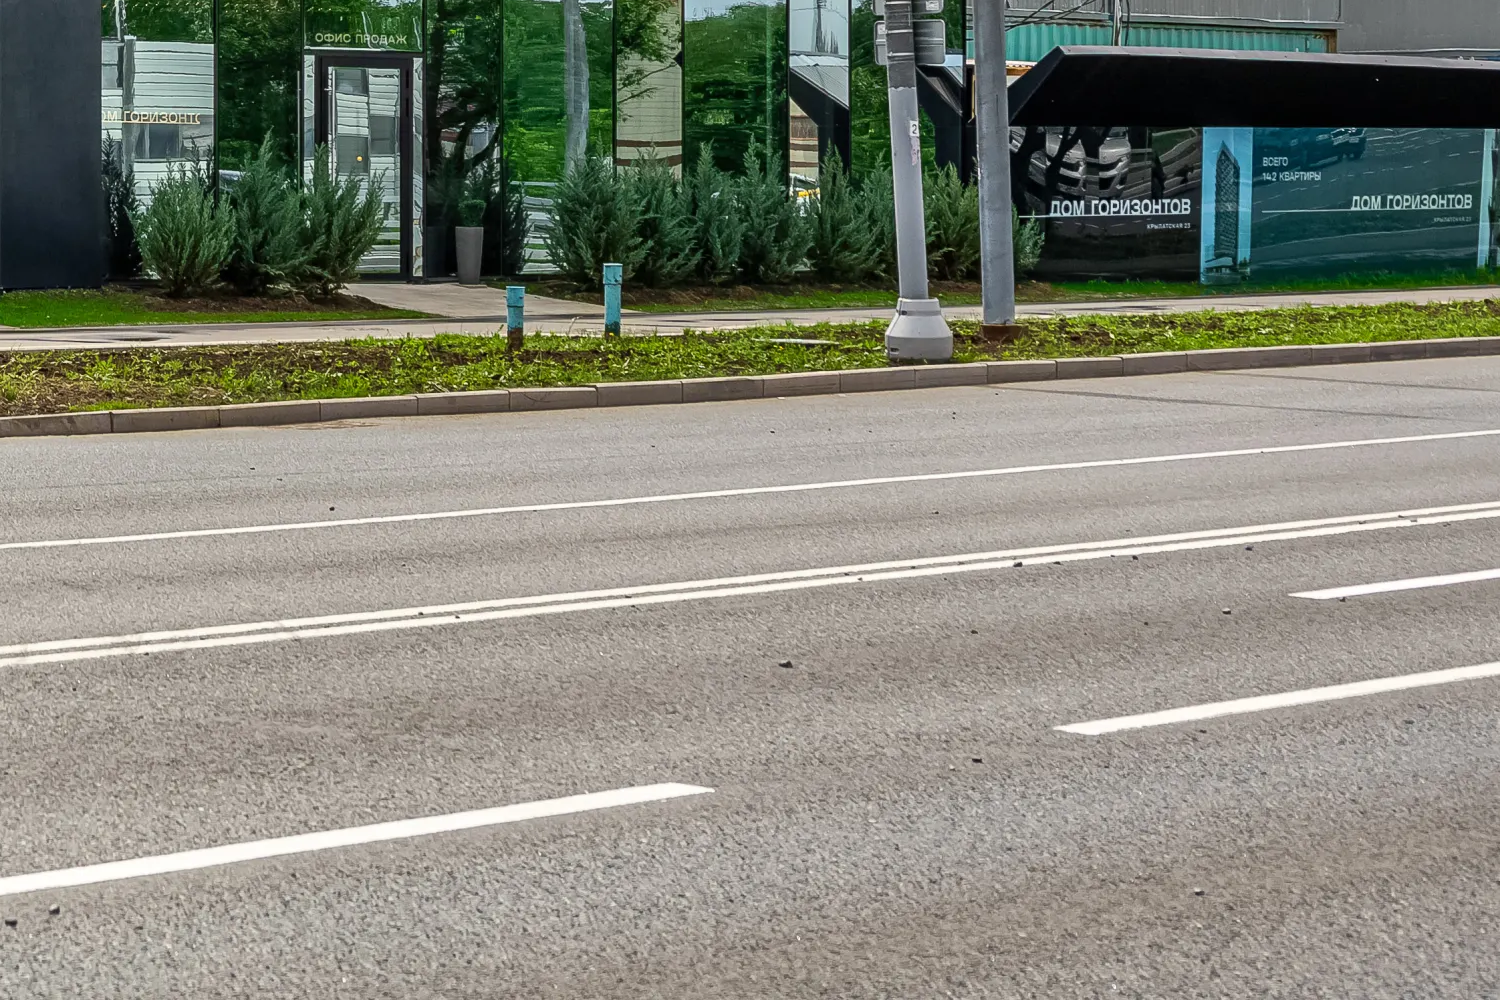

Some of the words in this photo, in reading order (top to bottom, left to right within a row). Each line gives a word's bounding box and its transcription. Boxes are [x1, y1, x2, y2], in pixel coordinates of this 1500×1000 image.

[315, 33, 351, 43] ОФИС
[355, 34, 407, 45] ПРОДАЖ
[912, 124, 917, 134] 2
[1262, 156, 1289, 167] ВСЕГО
[1262, 172, 1277, 181] 142
[1279, 171, 1322, 181] КВАРТИРЫ
[1049, 200, 1085, 216] ДОМ
[1091, 199, 1191, 216] ГОРИЗОНТОВ
[1351, 195, 1381, 210] ДОМ
[1387, 194, 1473, 209] ГОРИЗОНТОВ
